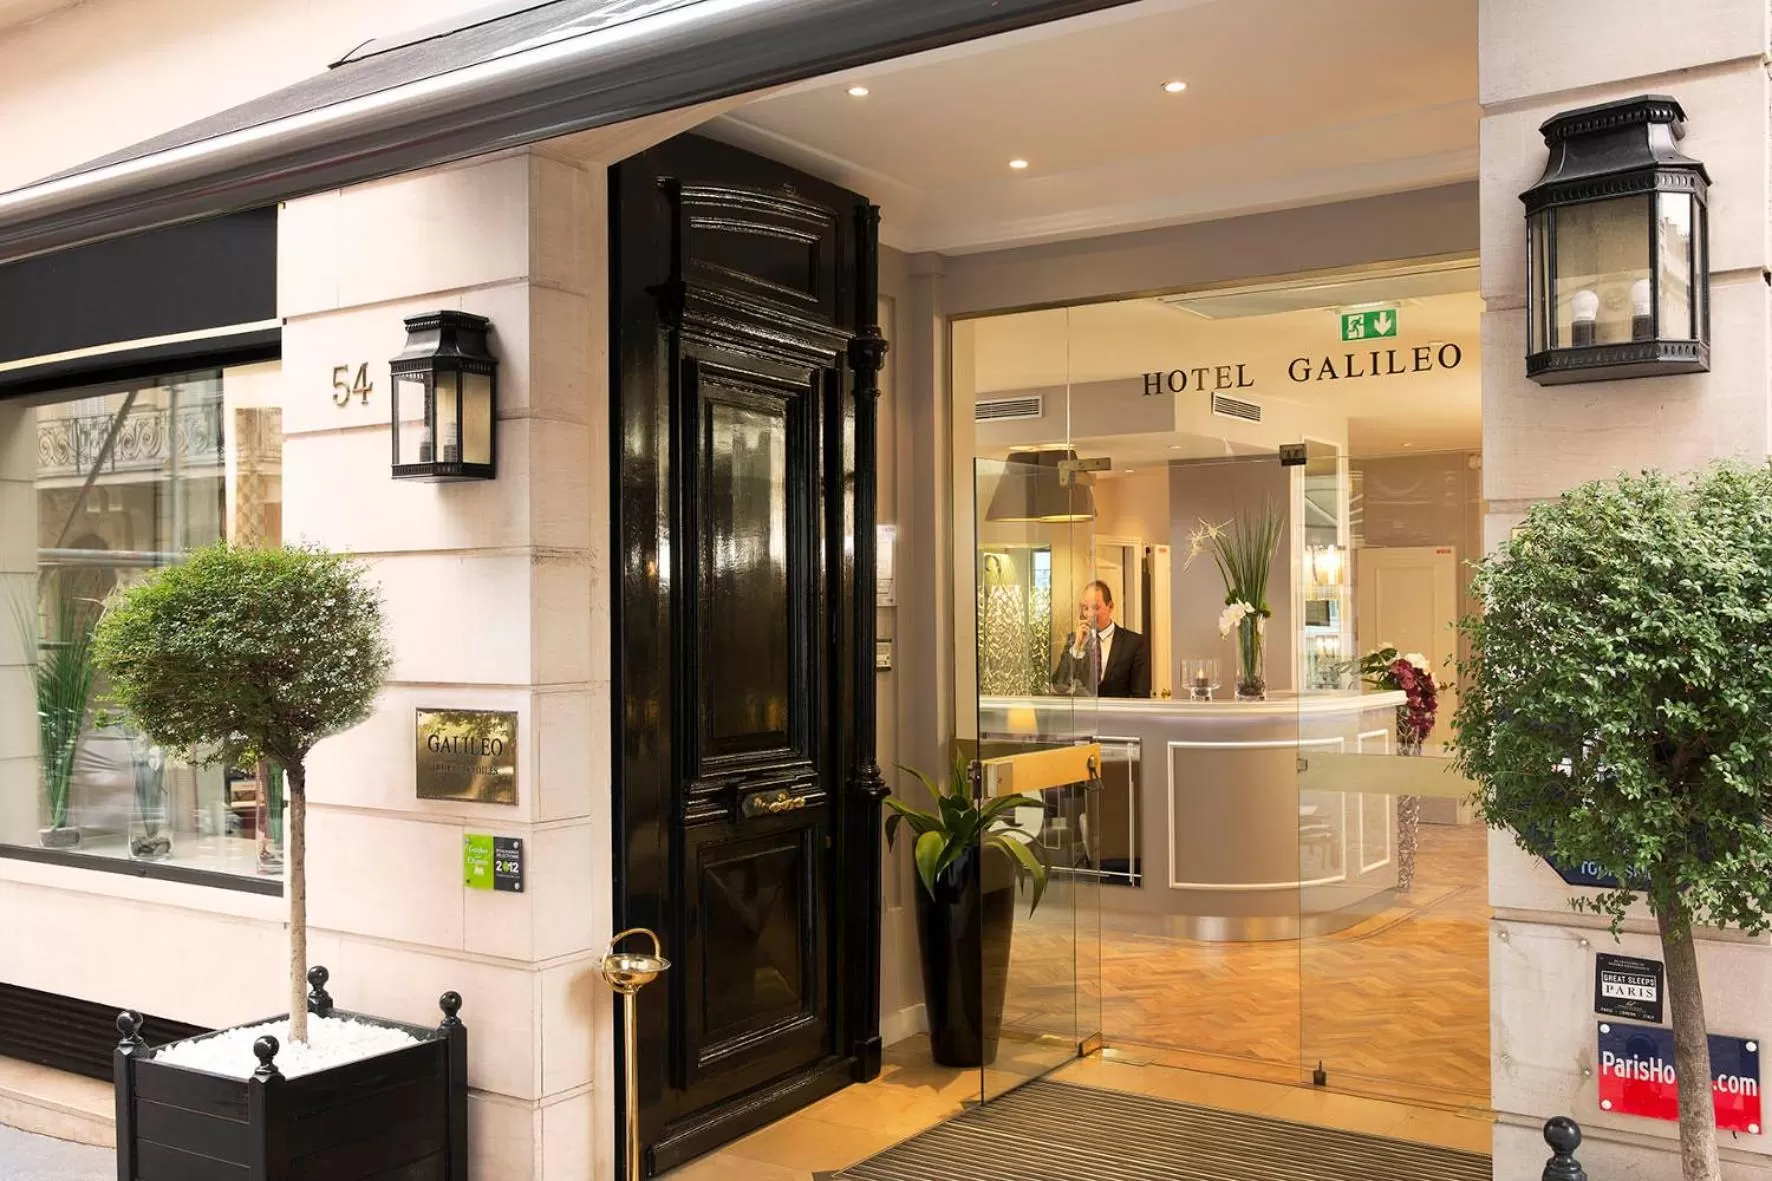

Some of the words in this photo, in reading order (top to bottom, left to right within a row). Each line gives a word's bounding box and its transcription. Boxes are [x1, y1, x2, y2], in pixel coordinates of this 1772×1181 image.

[332, 361, 374, 408] 54
[1143, 364, 1255, 396] HOTEL
[1288, 343, 1463, 382] GALILEO
[427, 734, 503, 757] GALILEO
[1603, 973, 1626, 983] GREAT
[1627, 976, 1655, 986] SLEEPS
[1605, 984, 1654, 999] PARIS
[1602, 1050, 1757, 1097] ParisHo.com
